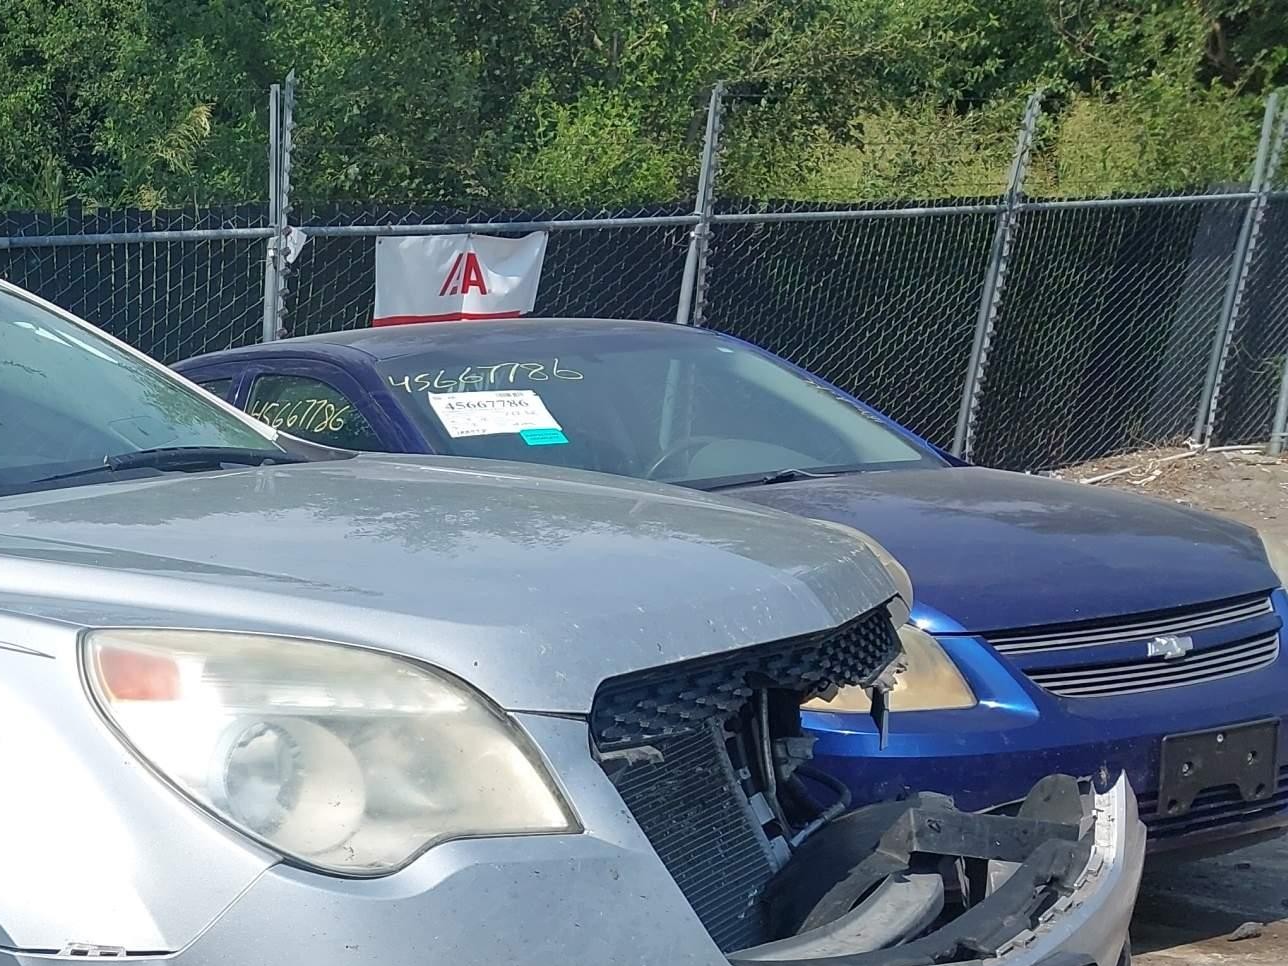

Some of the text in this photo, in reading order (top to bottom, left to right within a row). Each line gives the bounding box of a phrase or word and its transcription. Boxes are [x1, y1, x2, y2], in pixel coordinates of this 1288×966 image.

[388, 358, 583, 392] 45667786
[251, 399, 351, 433] 45667786
[445, 399, 529, 410] 45667786
